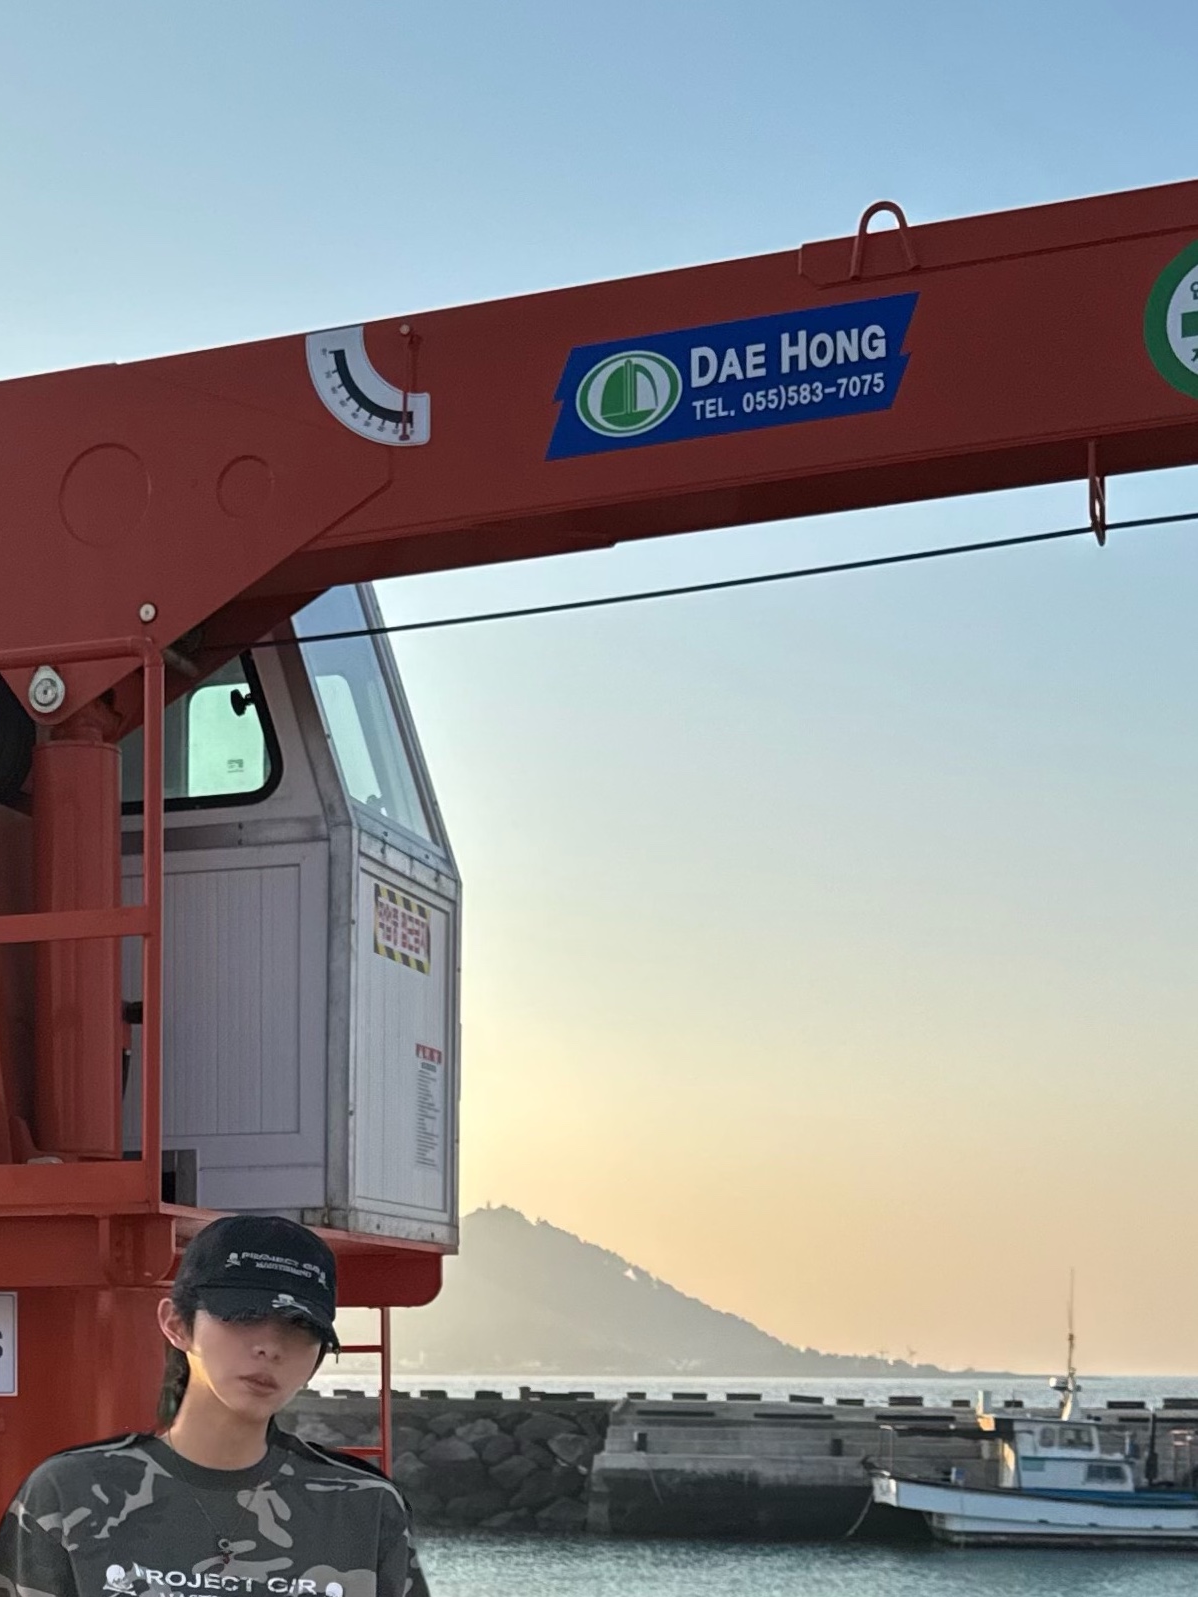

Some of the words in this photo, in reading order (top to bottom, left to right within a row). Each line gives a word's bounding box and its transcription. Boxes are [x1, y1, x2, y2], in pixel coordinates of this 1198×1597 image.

[690, 343, 766, 388] DAE
[780, 324, 887, 374] HONG
[692, 397, 736, 420] TEL.
[742, 372, 885, 413] 055)583-7075
